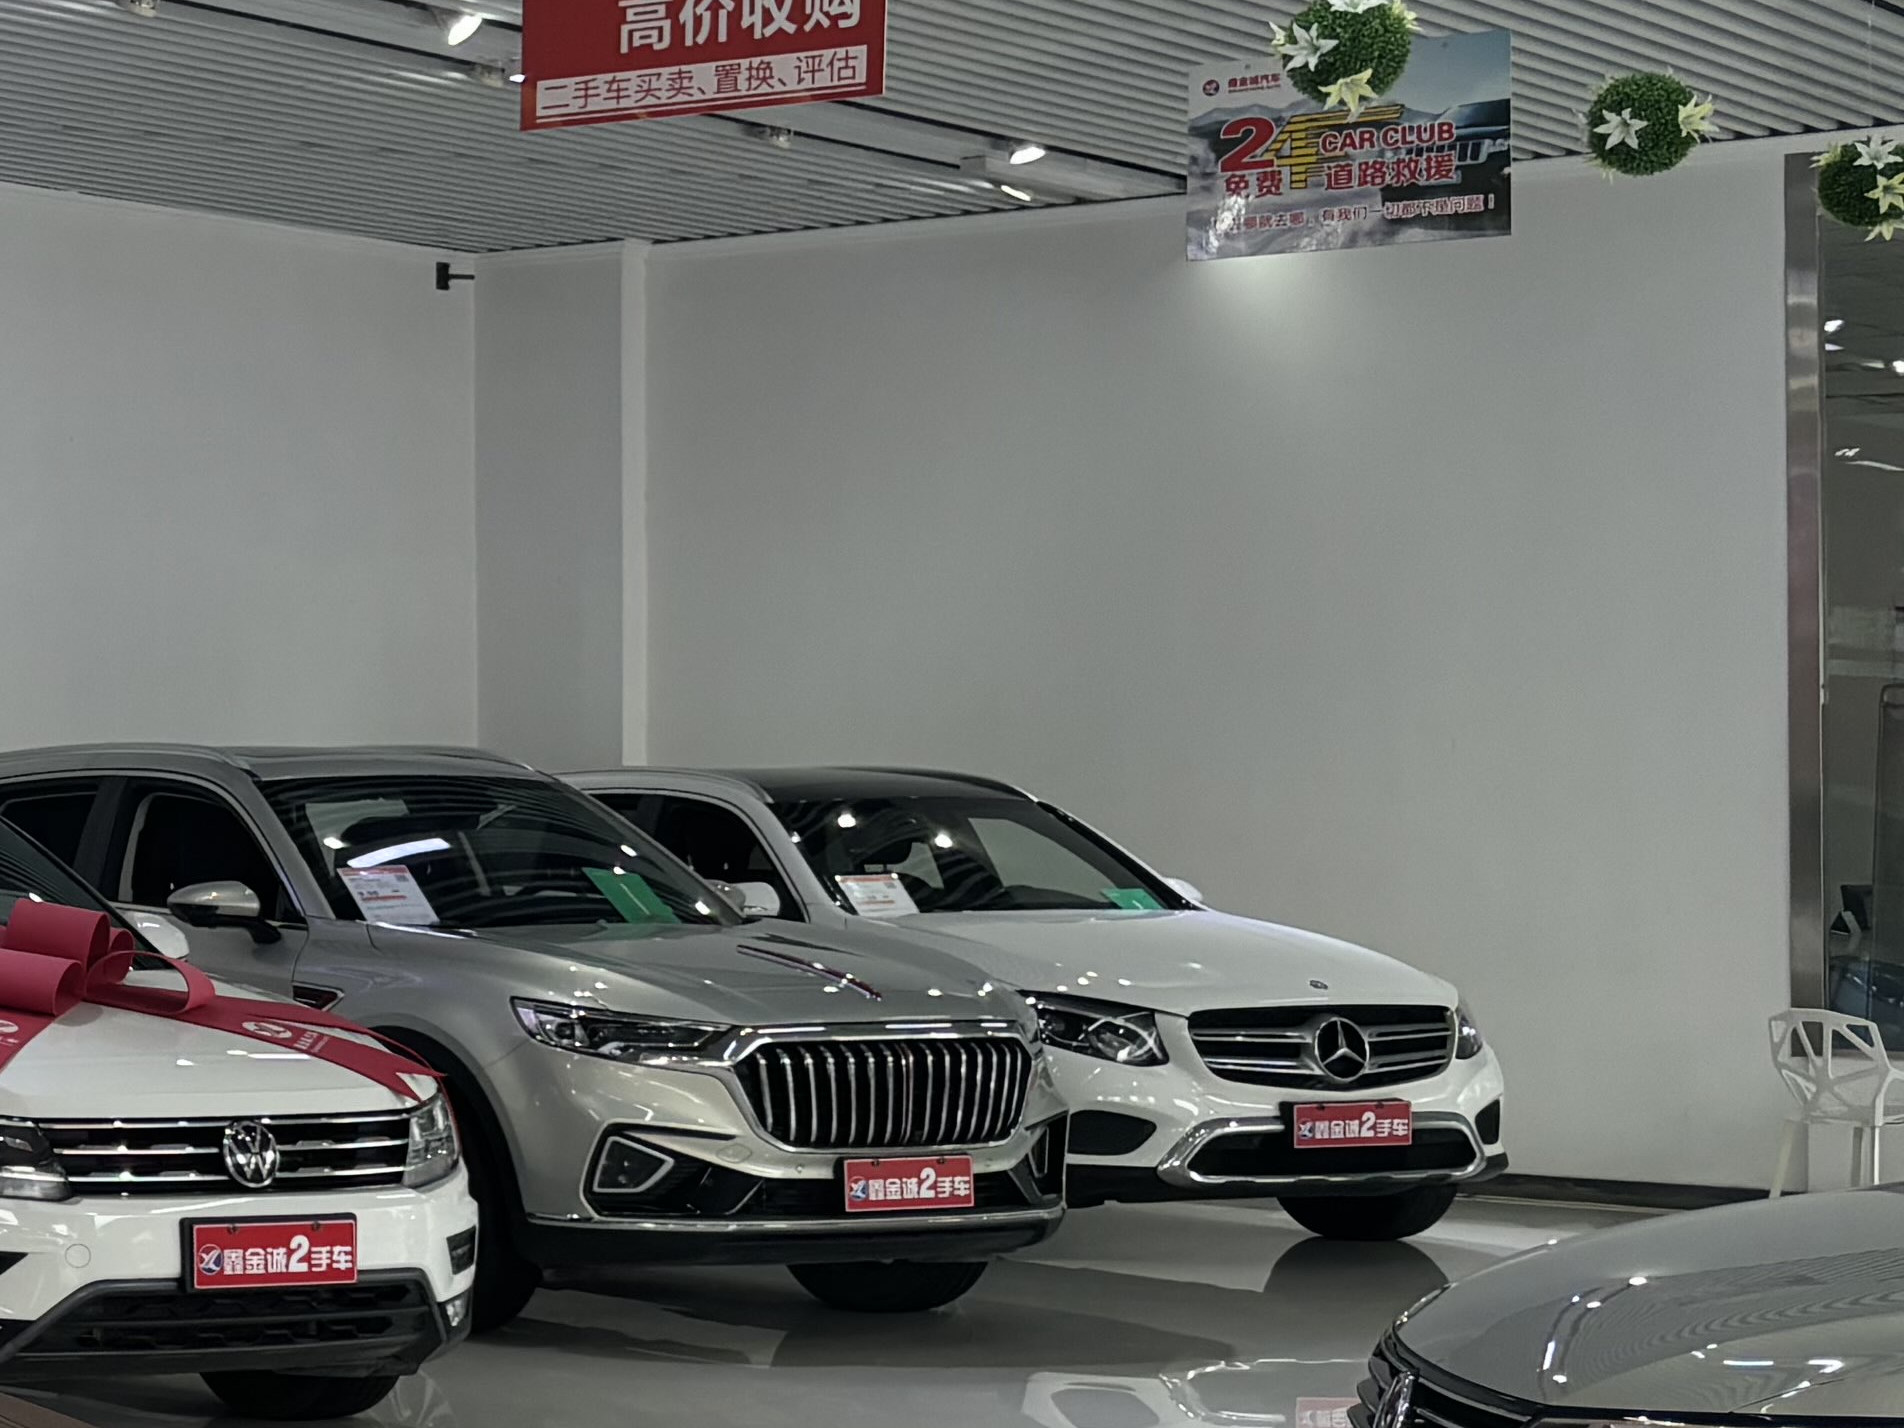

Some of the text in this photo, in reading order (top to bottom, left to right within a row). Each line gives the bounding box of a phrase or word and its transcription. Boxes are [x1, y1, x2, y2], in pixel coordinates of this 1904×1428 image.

[1320, 130, 1376, 155] CAR
[1380, 121, 1457, 150] CLUB
[1224, 152, 1458, 198] 免费 道路救援
[223, 1233, 354, 1276] 鑫金诚2手车
